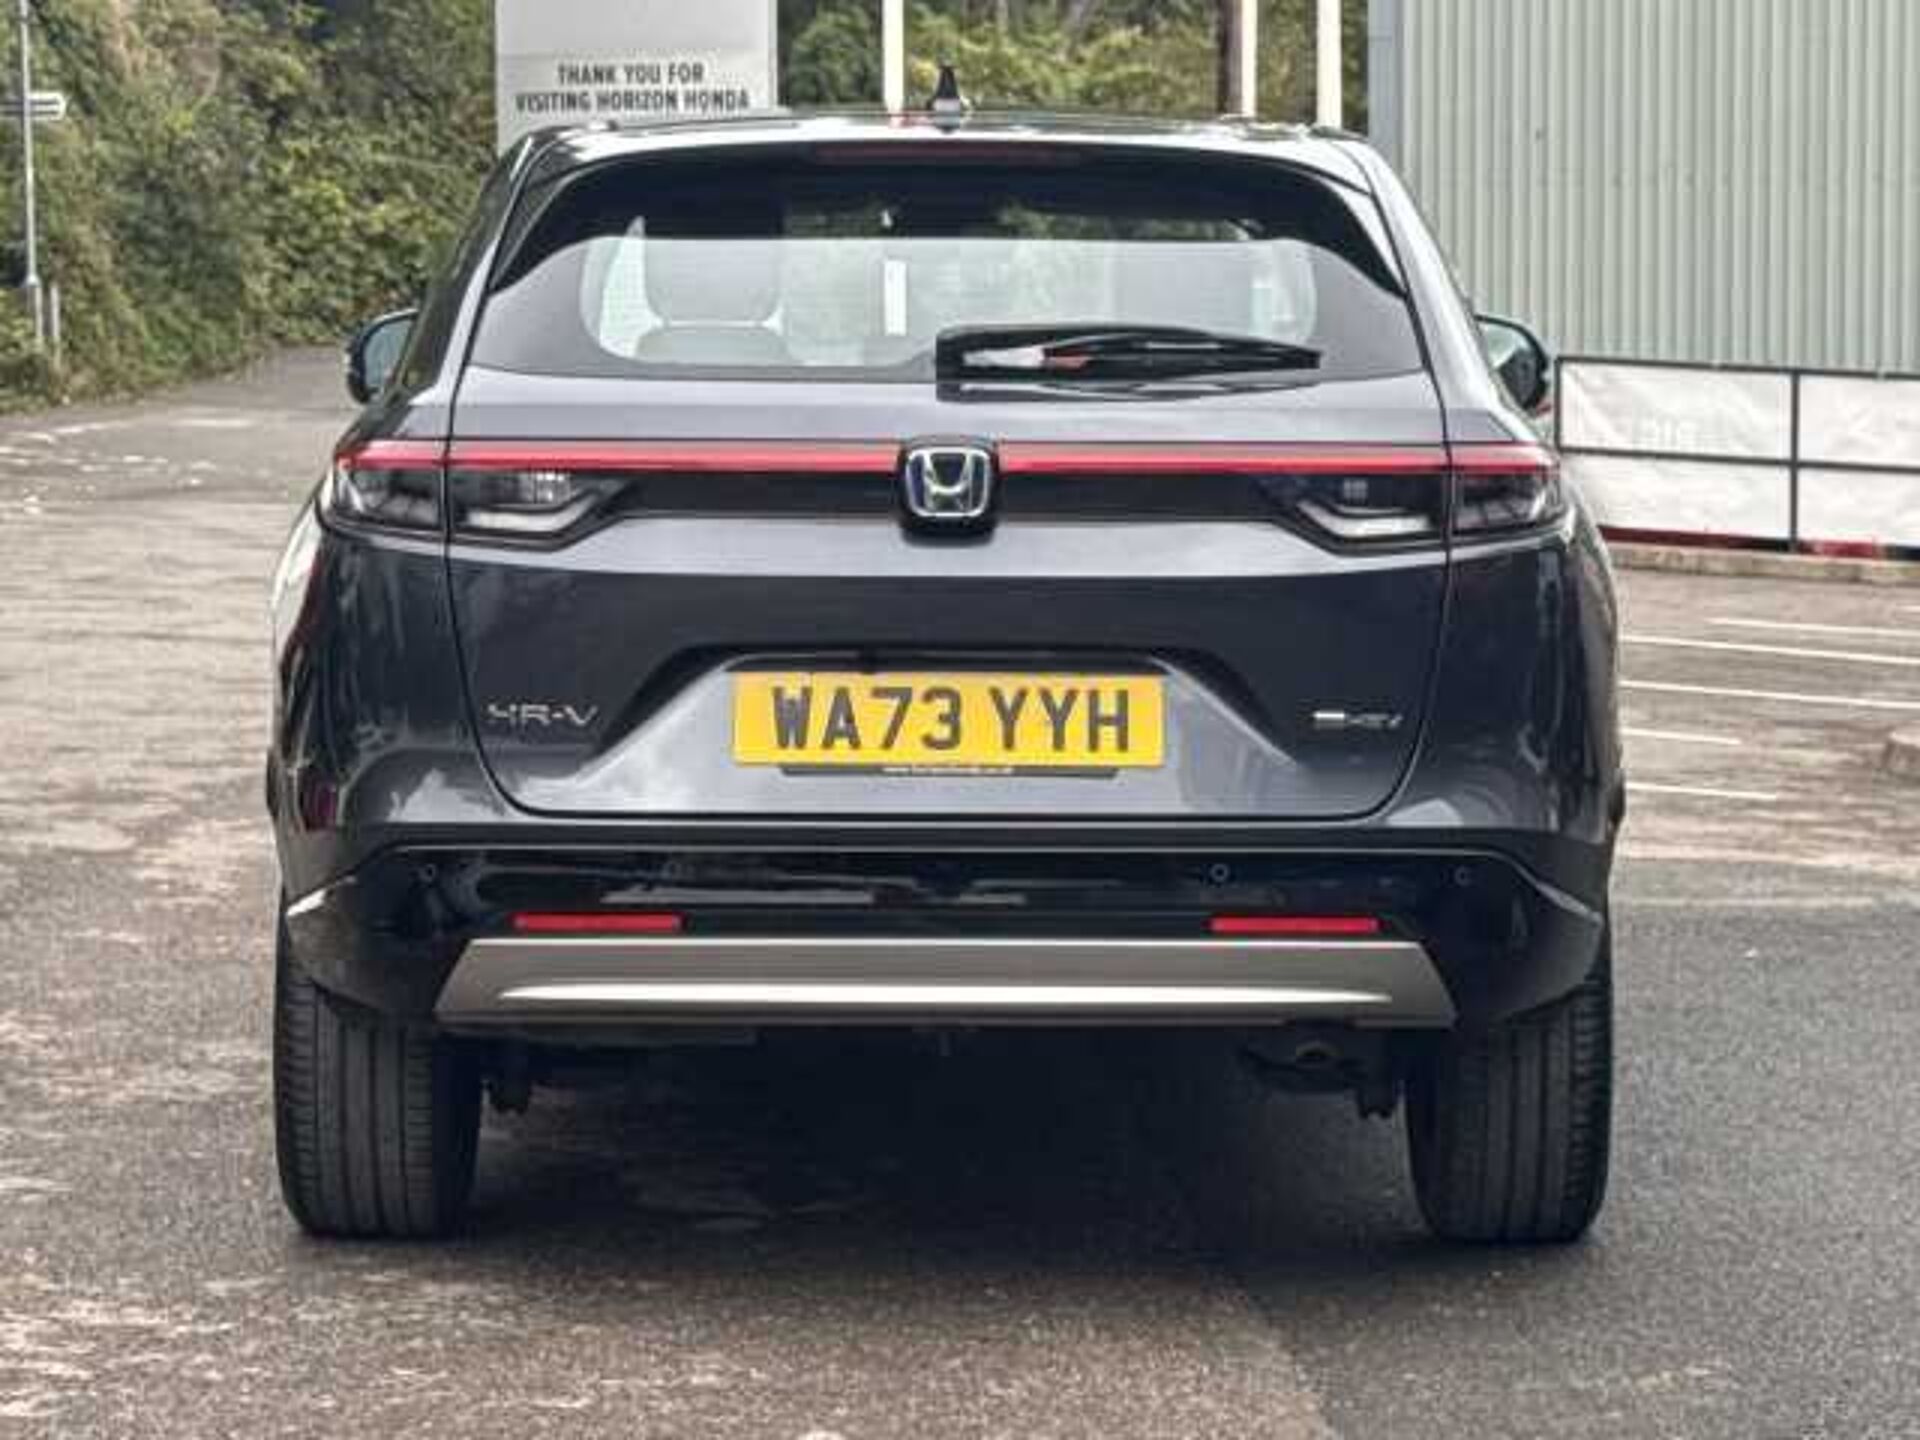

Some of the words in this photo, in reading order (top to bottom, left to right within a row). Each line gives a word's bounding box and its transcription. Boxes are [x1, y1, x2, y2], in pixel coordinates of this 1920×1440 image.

[557, 63, 616, 84] THANK
[625, 63, 660, 84] YOU
[668, 63, 704, 84] FOR
[515, 91, 590, 113] VISITING
[597, 91, 678, 112] HORIZON
[684, 90, 749, 110] HONDA
[487, 703, 598, 726] HR-V
[772, 686, 962, 751] WA73
[989, 687, 1130, 752] YYH
